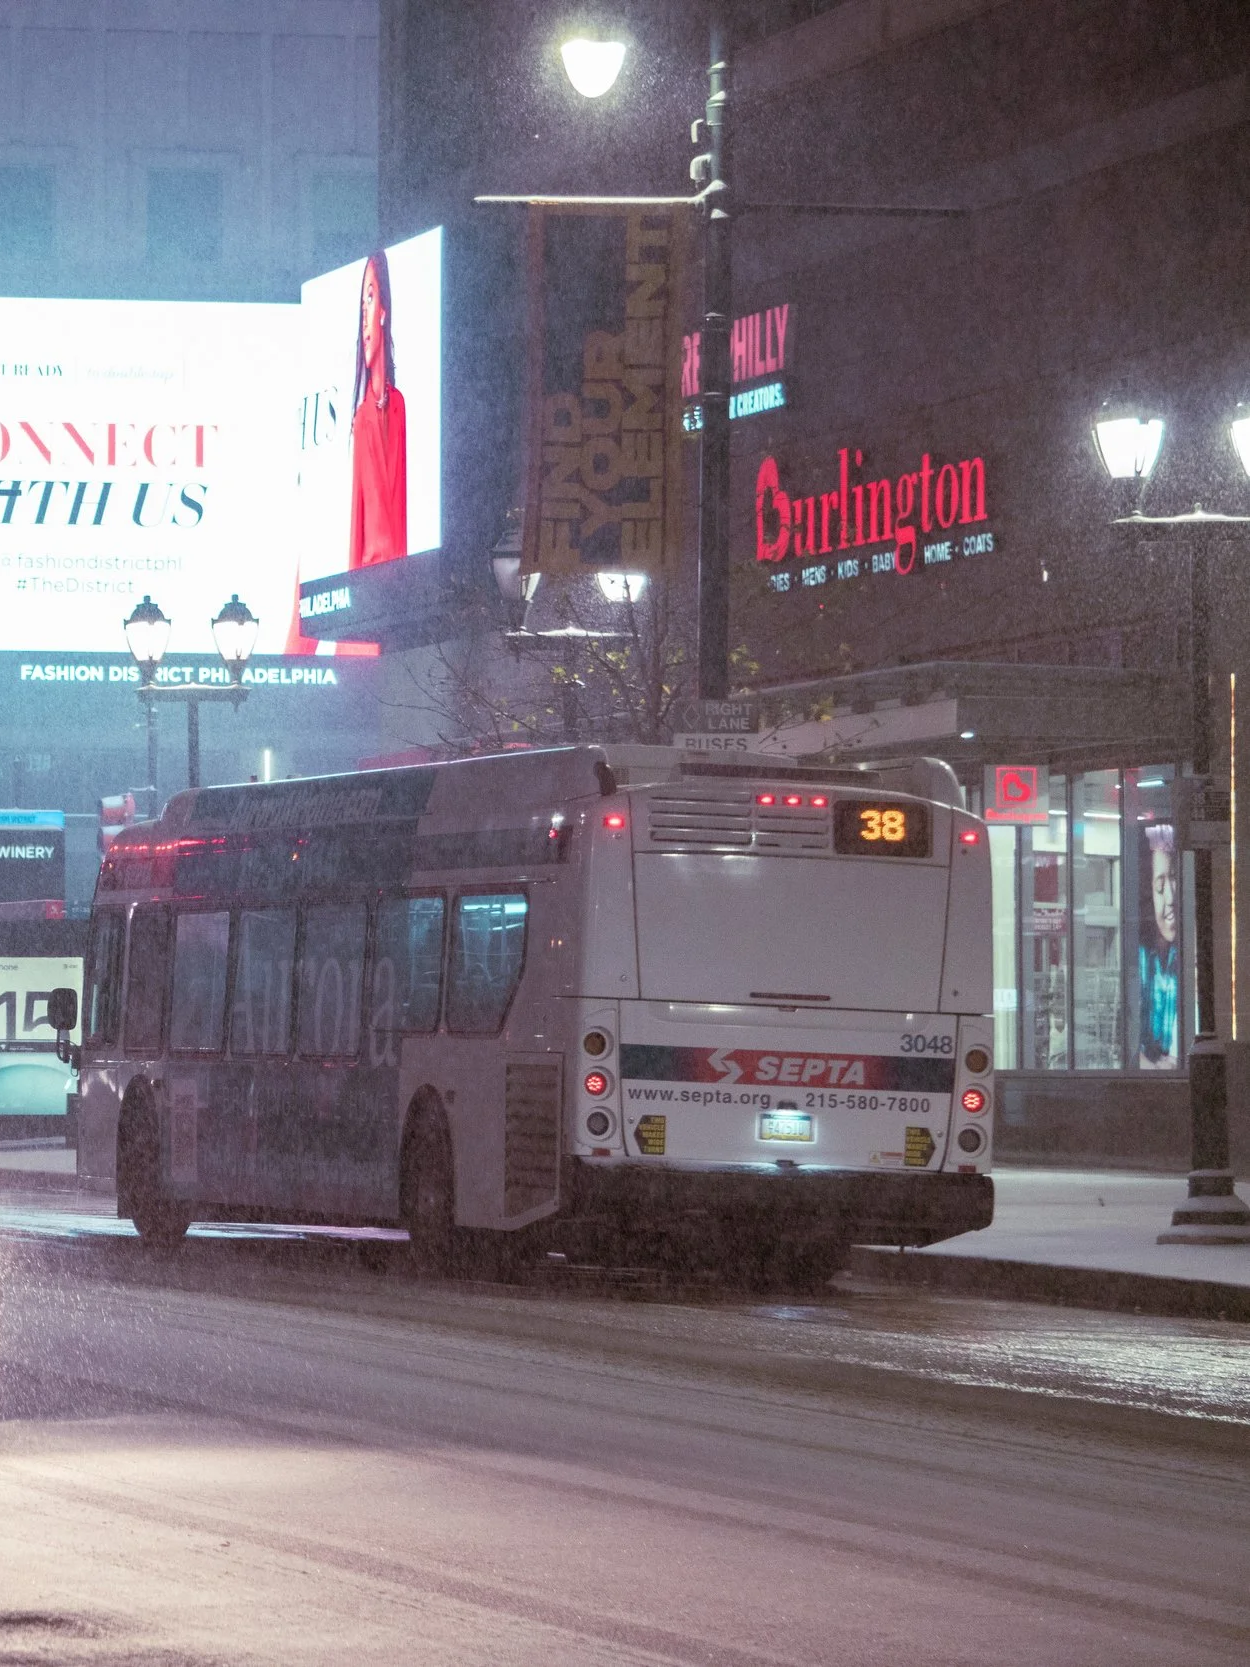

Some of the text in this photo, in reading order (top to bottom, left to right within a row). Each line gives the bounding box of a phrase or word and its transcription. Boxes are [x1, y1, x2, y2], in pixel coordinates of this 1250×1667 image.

[14, 364, 64, 377] READY
[540, 214, 670, 567] FIND YOUR ELEMENT
[132, 482, 209, 528] US
[755, 447, 989, 576] Burlington
[837, 559, 859, 580] KIDS
[871, 552, 897, 571] BABY
[923, 541, 952, 565] HOME
[962, 532, 994, 557] COATS
[16, 577, 135, 594] #TheDistrict
[20, 664, 338, 686] FASHION DISRICT PHIADELPHIA
[705, 703, 753, 717] RIGHT
[708, 717, 751, 731] LANE
[685, 737, 748, 752] BUSES
[859, 809, 906, 842] 38
[900, 1033, 954, 1055] 3048
[755, 1055, 866, 1086] SEPTA
[627, 1087, 931, 1114] www.septa.org 215-580-7800
